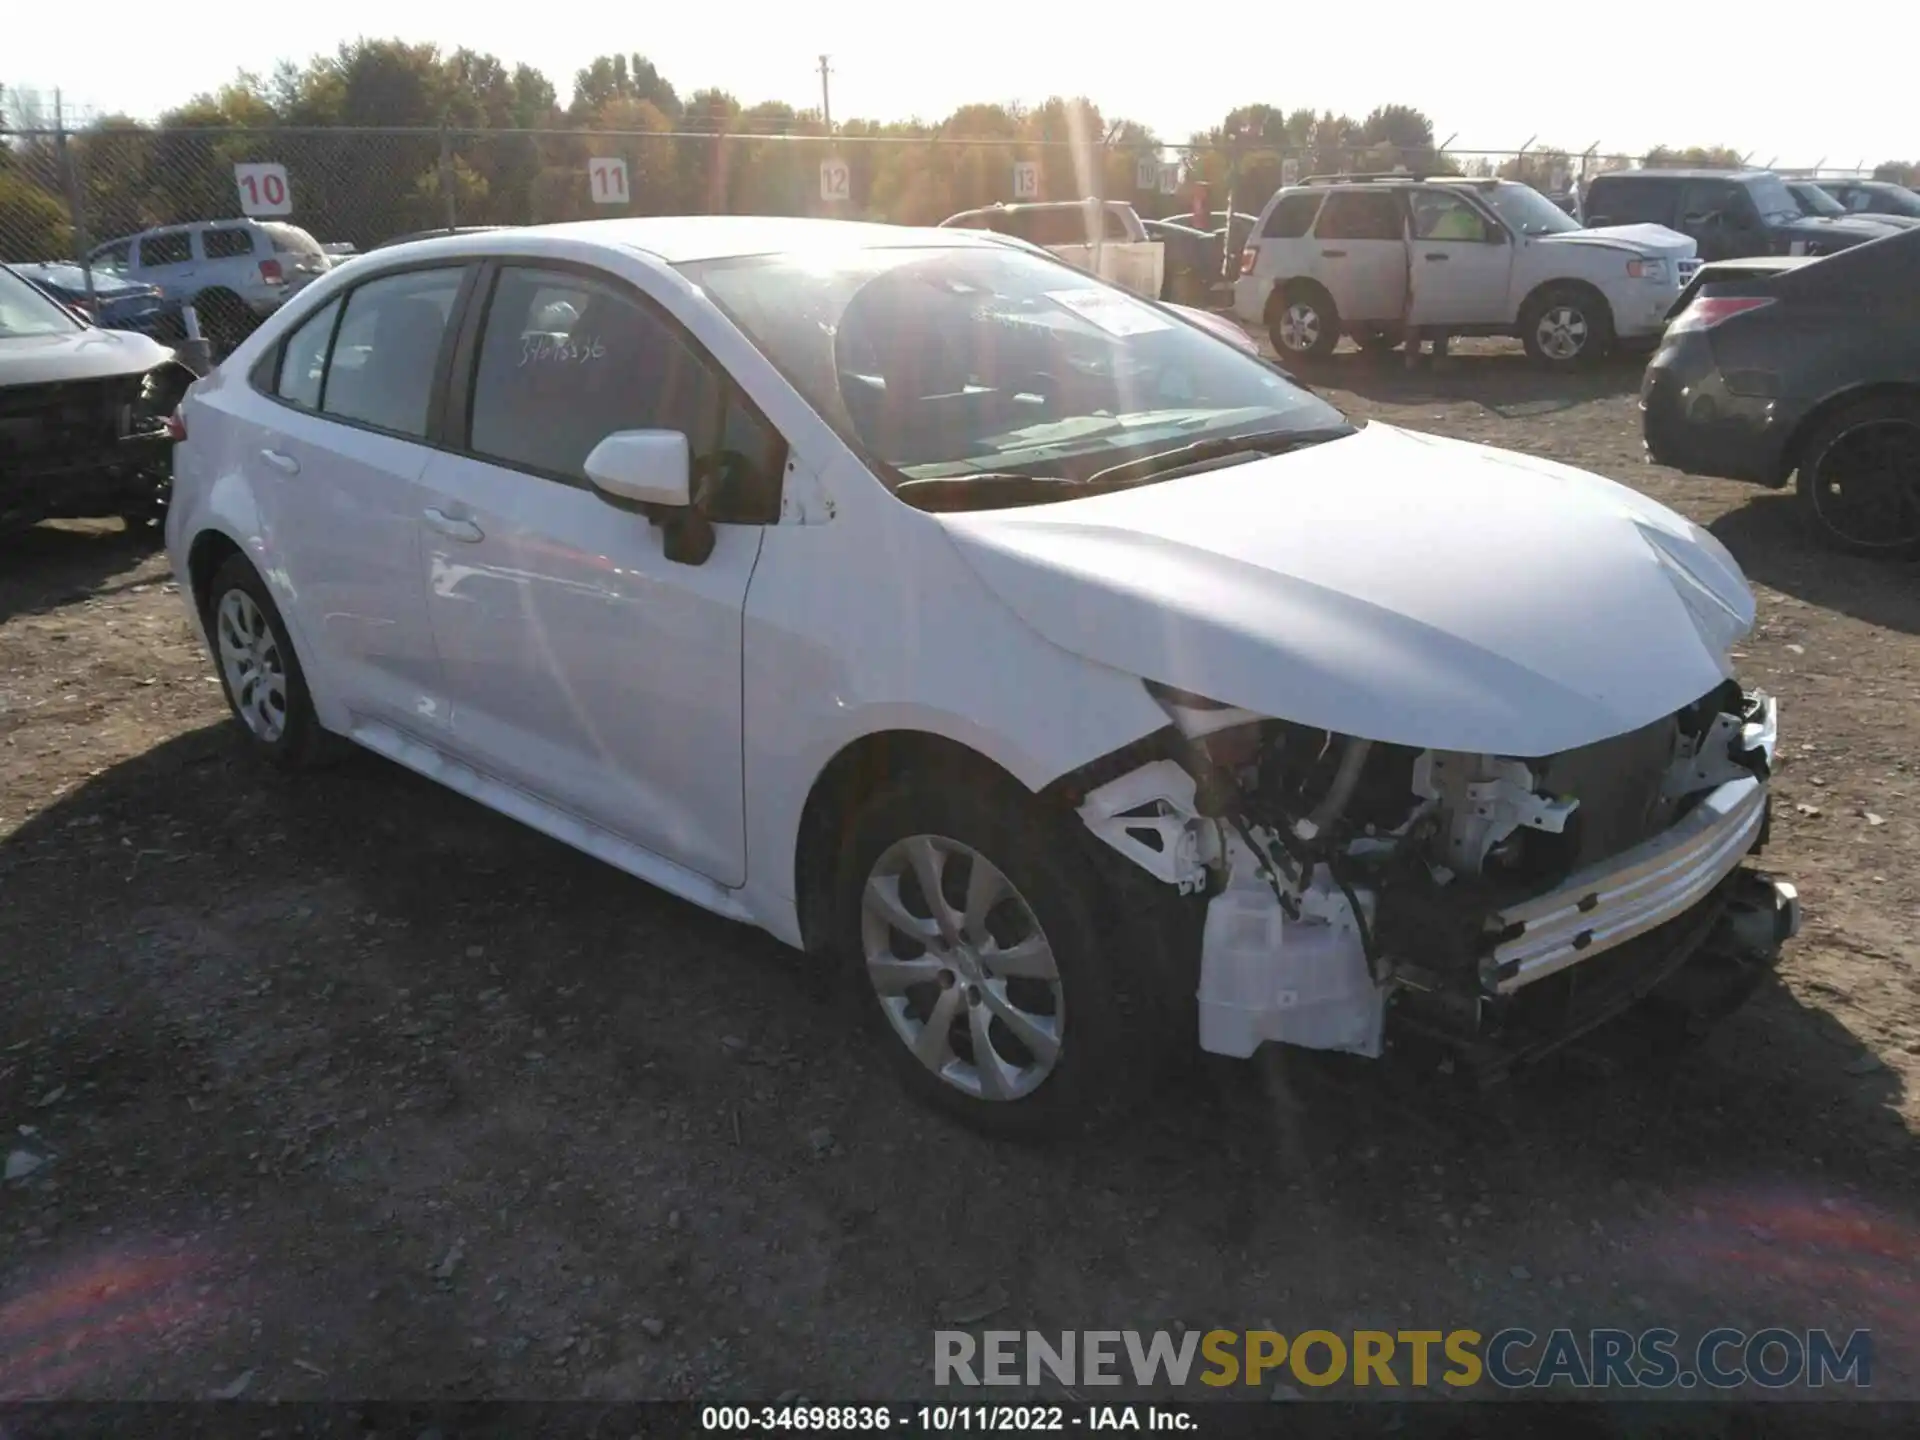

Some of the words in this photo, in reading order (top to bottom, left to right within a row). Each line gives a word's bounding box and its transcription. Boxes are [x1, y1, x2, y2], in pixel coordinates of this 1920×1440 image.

[240, 174, 284, 205] 10
[595, 166, 624, 195] 11
[823, 169, 847, 193] 12
[1017, 169, 1035, 191] 13
